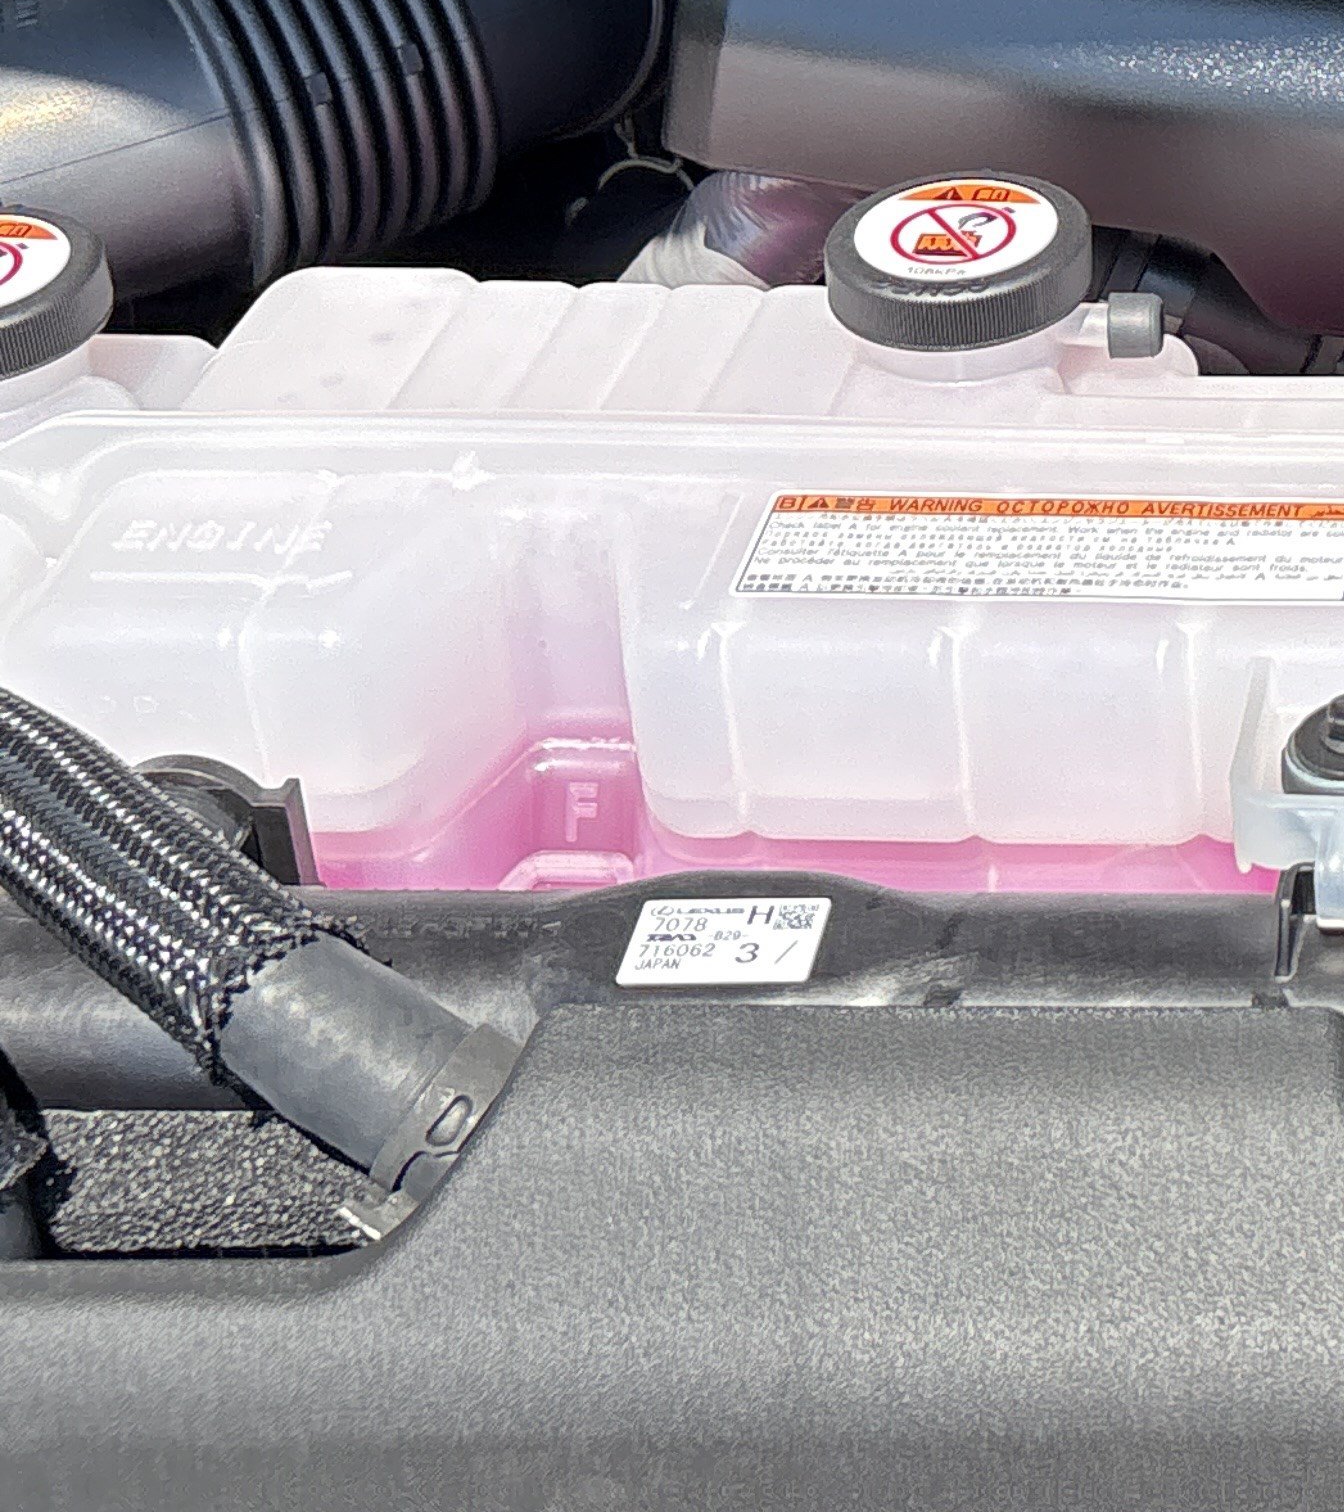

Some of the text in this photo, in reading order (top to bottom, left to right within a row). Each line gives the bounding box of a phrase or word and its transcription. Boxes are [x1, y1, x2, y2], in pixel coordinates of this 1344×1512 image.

[779, 497, 797, 509] B
[889, 498, 983, 513] WARNING
[996, 501, 1130, 515] ОСТОРОЖНО
[1141, 502, 1303, 518] AVERTISSEMENT
[564, 781, 600, 843] F
[654, 916, 709, 932] 7078
[747, 905, 776, 925] H
[638, 942, 716, 958] 716062
[735, 942, 761, 964] 3
[635, 958, 682, 971] JAPAN
